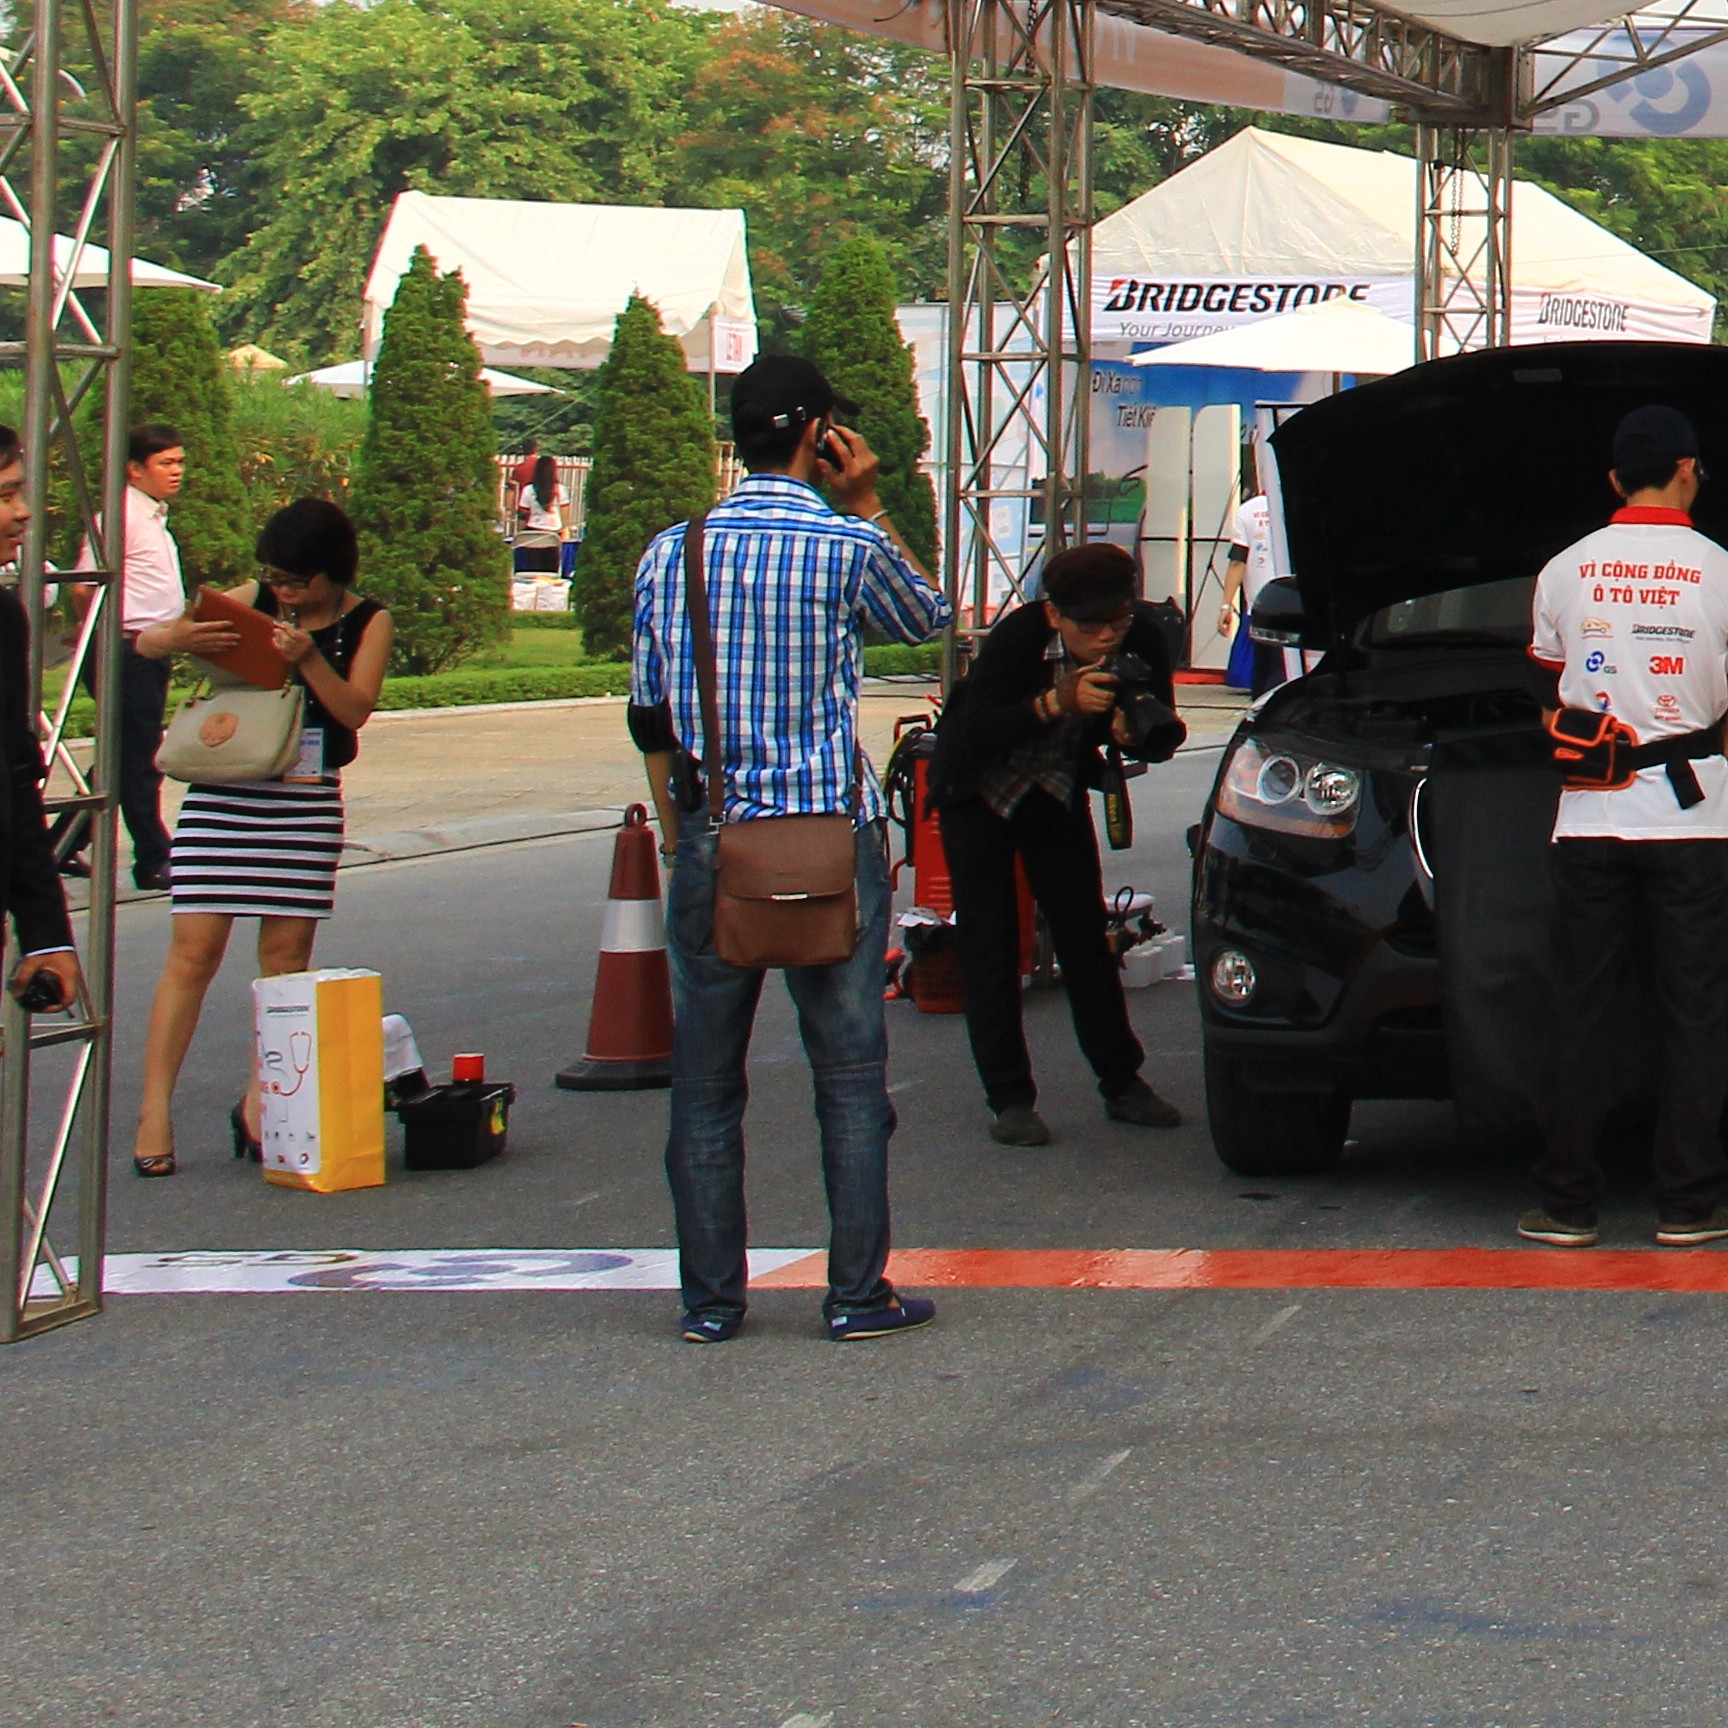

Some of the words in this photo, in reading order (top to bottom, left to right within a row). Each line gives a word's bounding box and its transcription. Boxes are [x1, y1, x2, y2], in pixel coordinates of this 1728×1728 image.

[1538, 292, 1629, 332] BRIDGESTONE
[1119, 321, 1164, 337] Your
[1579, 560, 1596, 579] VÌ
[1602, 559, 1649, 582] CỘNG
[1653, 558, 1702, 584] ĐỒNG
[1593, 583, 1604, 602] Ô
[1609, 584, 1633, 603] TÔ
[1639, 586, 1681, 609] VIỆT
[1649, 656, 1684, 675] 3M
